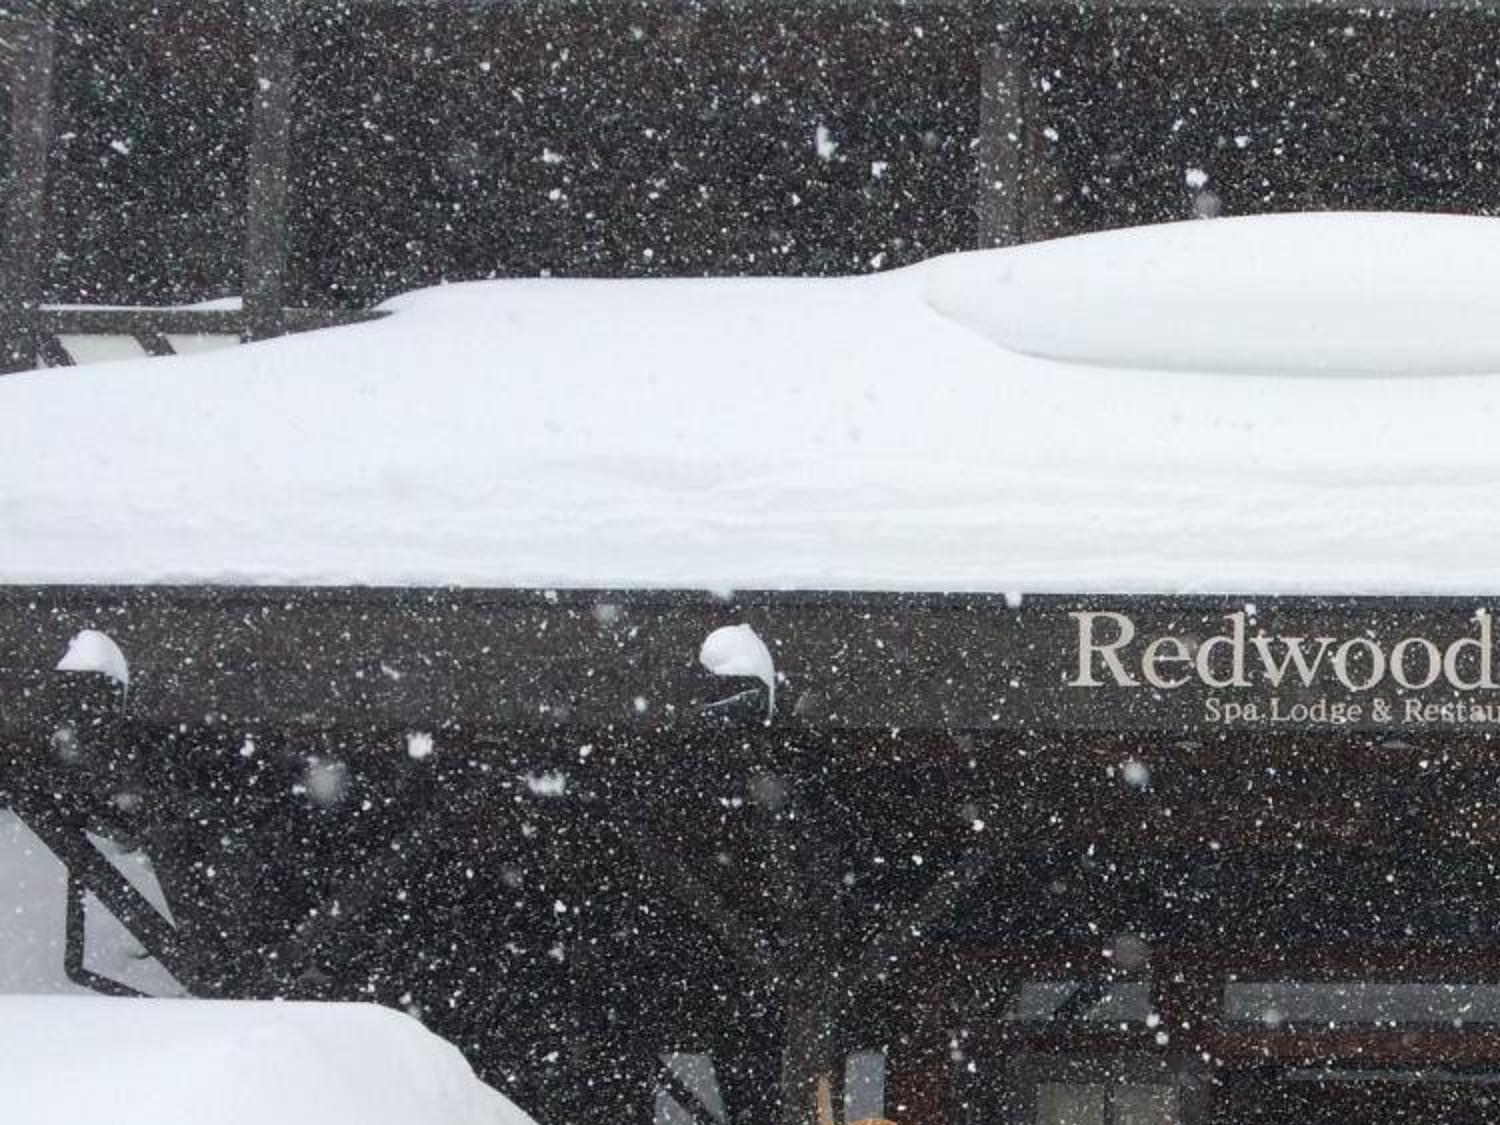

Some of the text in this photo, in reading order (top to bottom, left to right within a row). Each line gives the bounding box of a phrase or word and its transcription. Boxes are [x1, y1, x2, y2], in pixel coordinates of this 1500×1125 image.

[1204, 698, 1259, 725] Spa
[1270, 698, 1362, 725] Lodge
[1371, 699, 1392, 723] &
